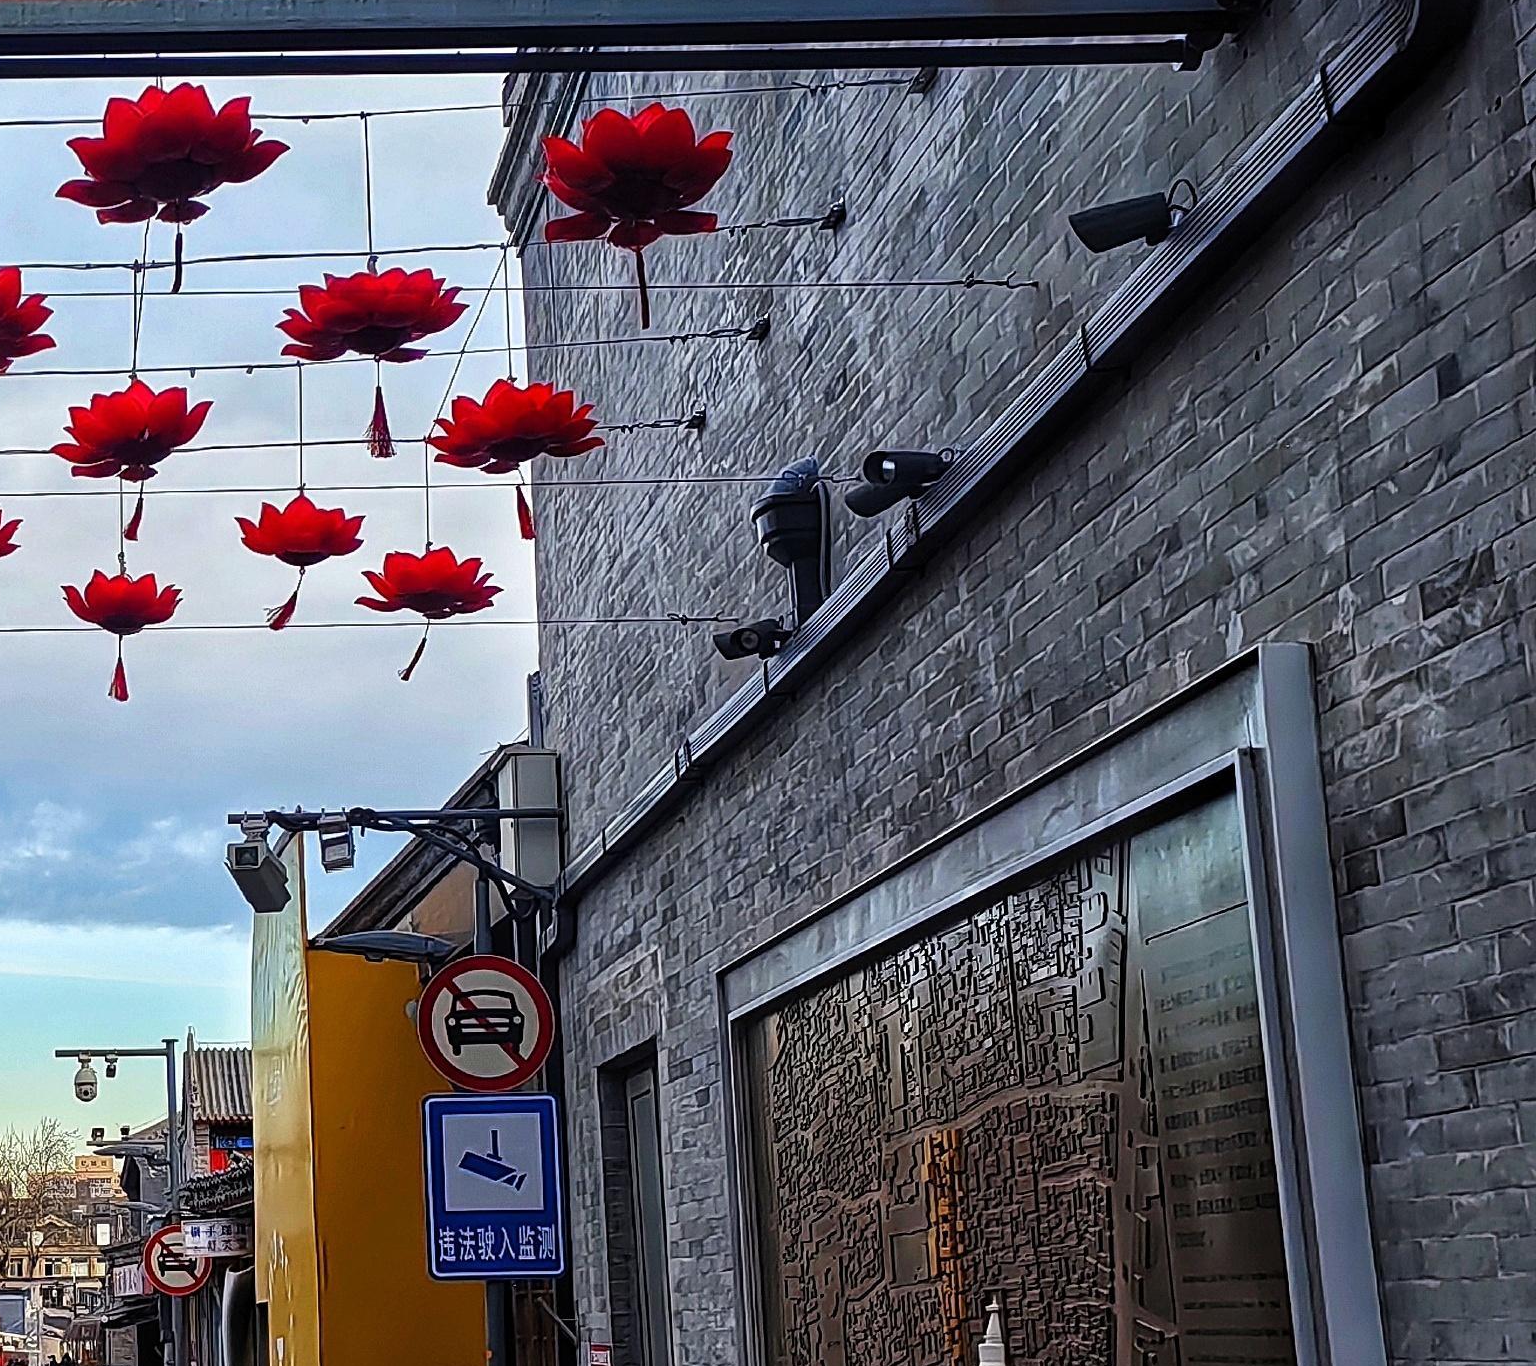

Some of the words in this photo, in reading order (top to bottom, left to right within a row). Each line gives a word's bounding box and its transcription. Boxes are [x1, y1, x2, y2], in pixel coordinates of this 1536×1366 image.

[438, 1224, 557, 1262] 违法驶入监测
